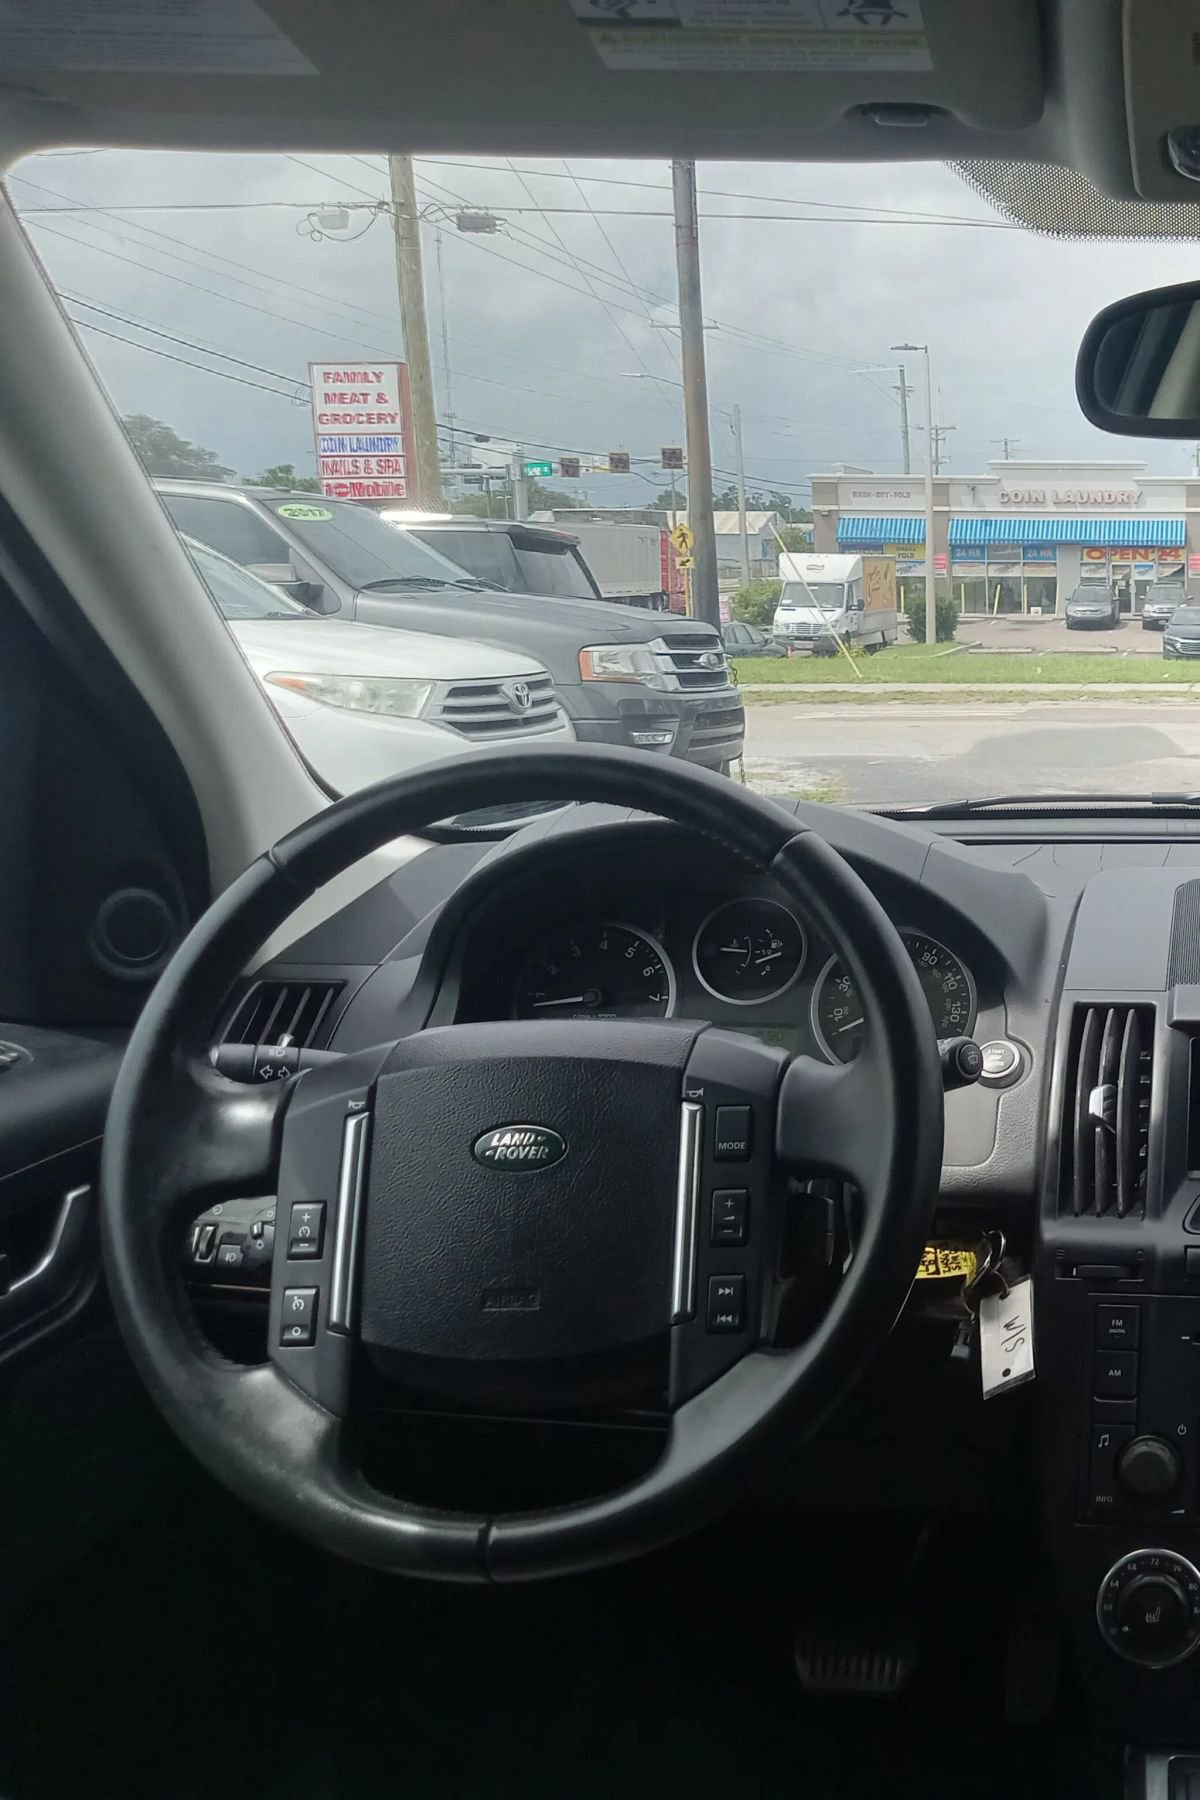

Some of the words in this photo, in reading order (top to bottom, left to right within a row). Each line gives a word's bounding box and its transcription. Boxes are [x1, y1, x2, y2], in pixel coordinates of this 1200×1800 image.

[322, 371, 385, 384] FAMILY
[323, 392, 371, 405] MEAT
[376, 392, 389, 404] &
[317, 412, 399, 425] GROCERY
[319, 436, 348, 454] COIN
[349, 436, 400, 453] LAUNDRY
[321, 459, 361, 476] NAILS
[364, 459, 374, 475] &
[376, 458, 402, 475] SPA
[350, 482, 406, 497] Mobile
[999, 489, 1046, 504] COIN
[1053, 489, 1144, 505] LAUNDRY
[1086, 548, 1151, 561] OPEN
[625, 947, 637, 959] 5
[921, 951, 938, 966] 90
[642, 966, 655, 977] 6
[838, 975, 851, 993] 30
[944, 972, 958, 991] 110
[648, 992, 661, 1002] 7
[833, 1008, 844, 1022] 10
[950, 1001, 961, 1023] 130
[491, 1132, 537, 1147] LAND
[718, 1141, 746, 1150] MODE
[494, 1146, 550, 1160] ROVER
[1111, 1319, 1123, 1327] FM
[1108, 1369, 1122, 1377] AM
